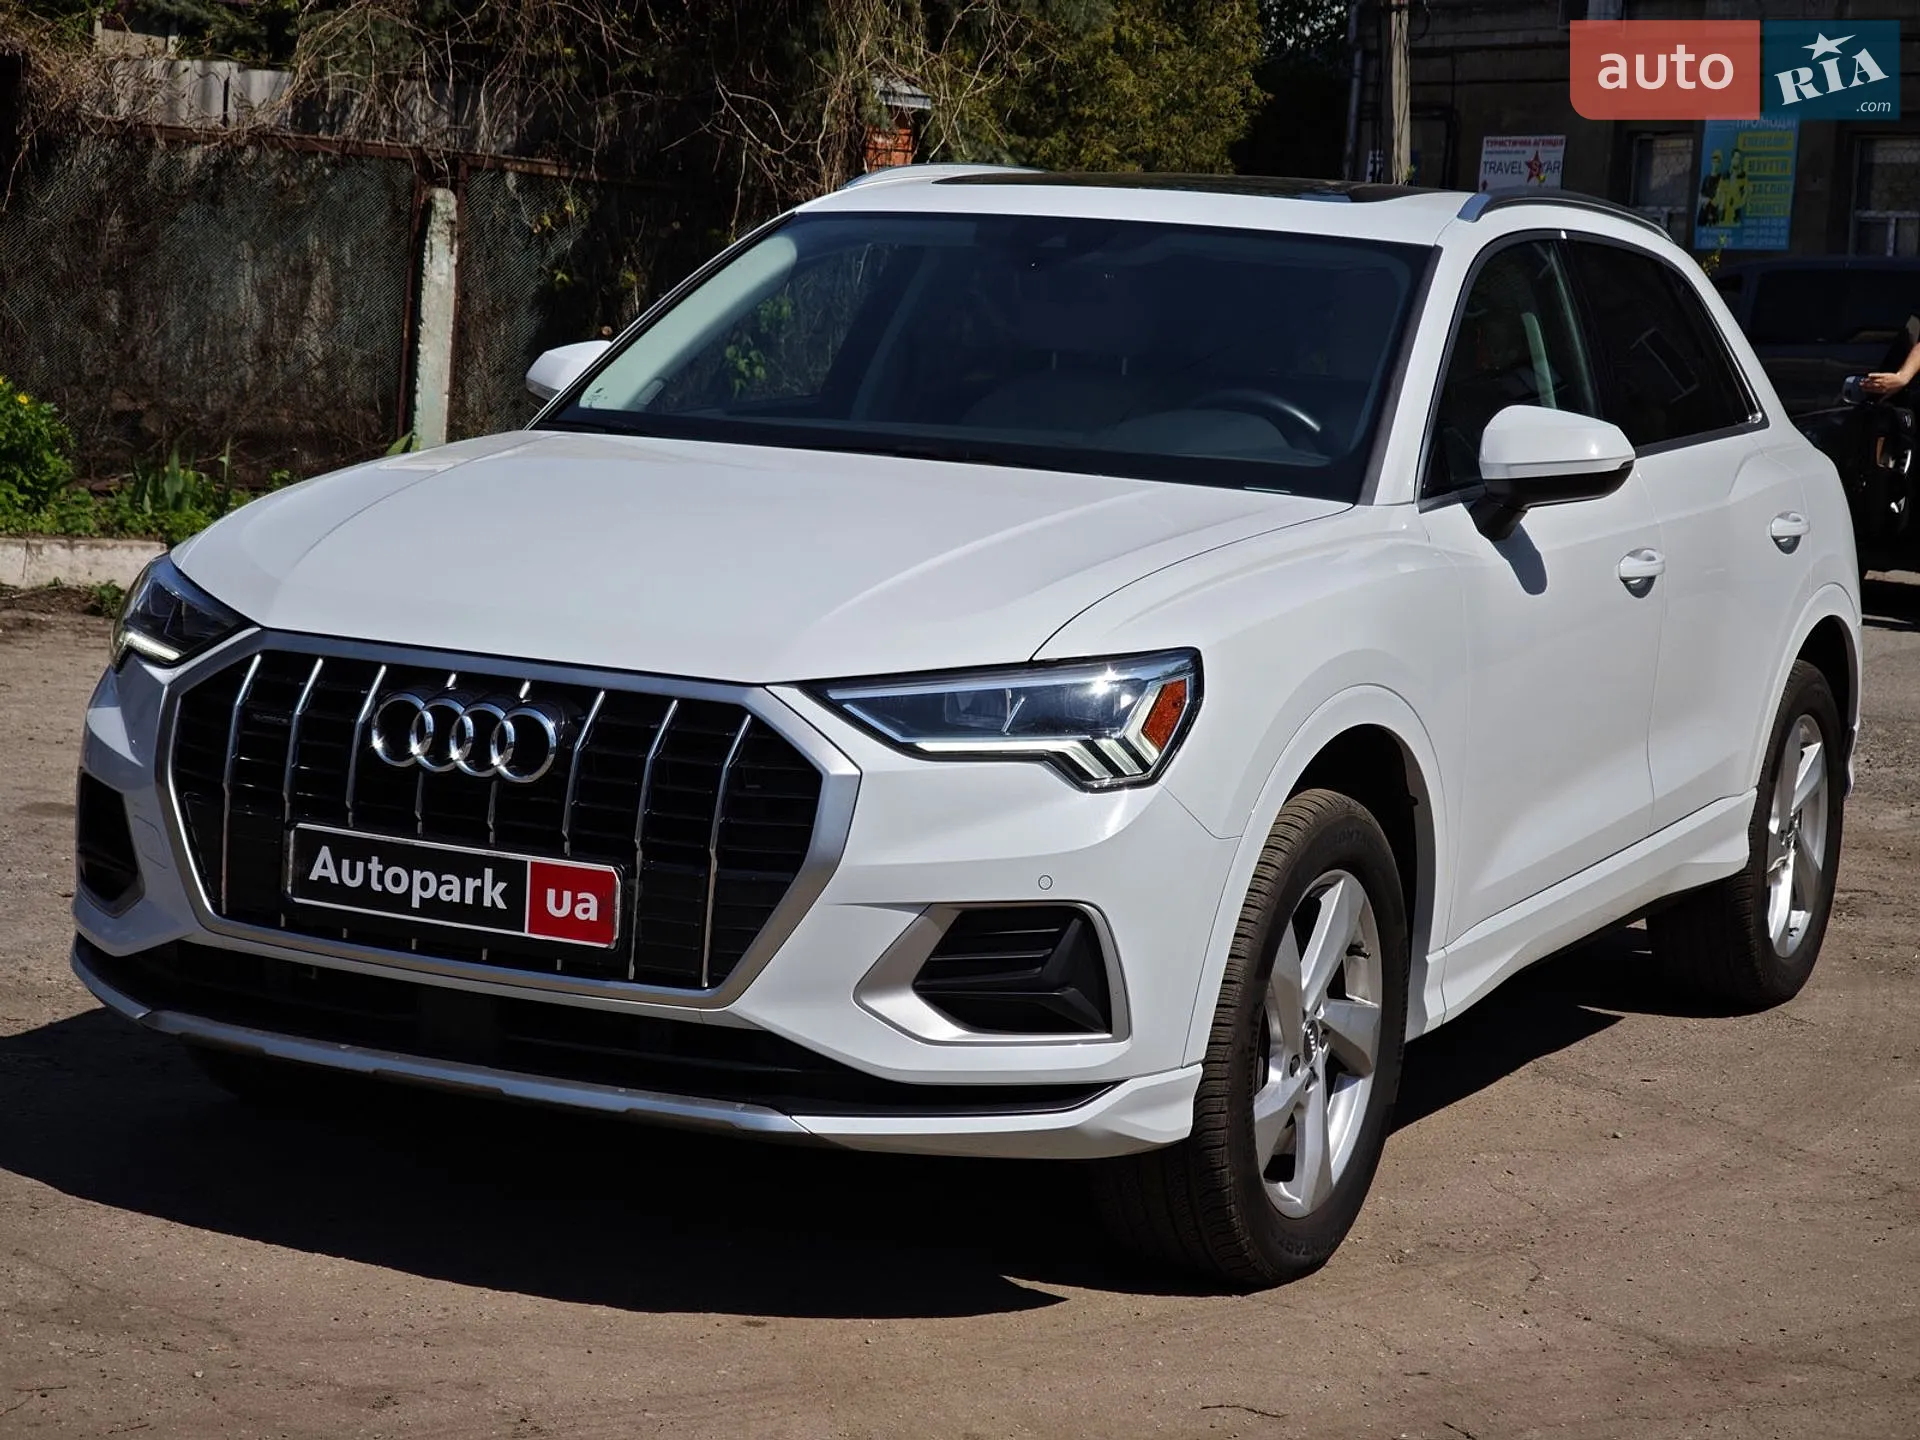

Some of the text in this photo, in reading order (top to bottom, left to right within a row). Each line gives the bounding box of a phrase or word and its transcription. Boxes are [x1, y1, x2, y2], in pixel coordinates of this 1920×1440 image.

[1484, 160, 1524, 175] TRAVEL
[308, 845, 598, 921] Autopark ua
